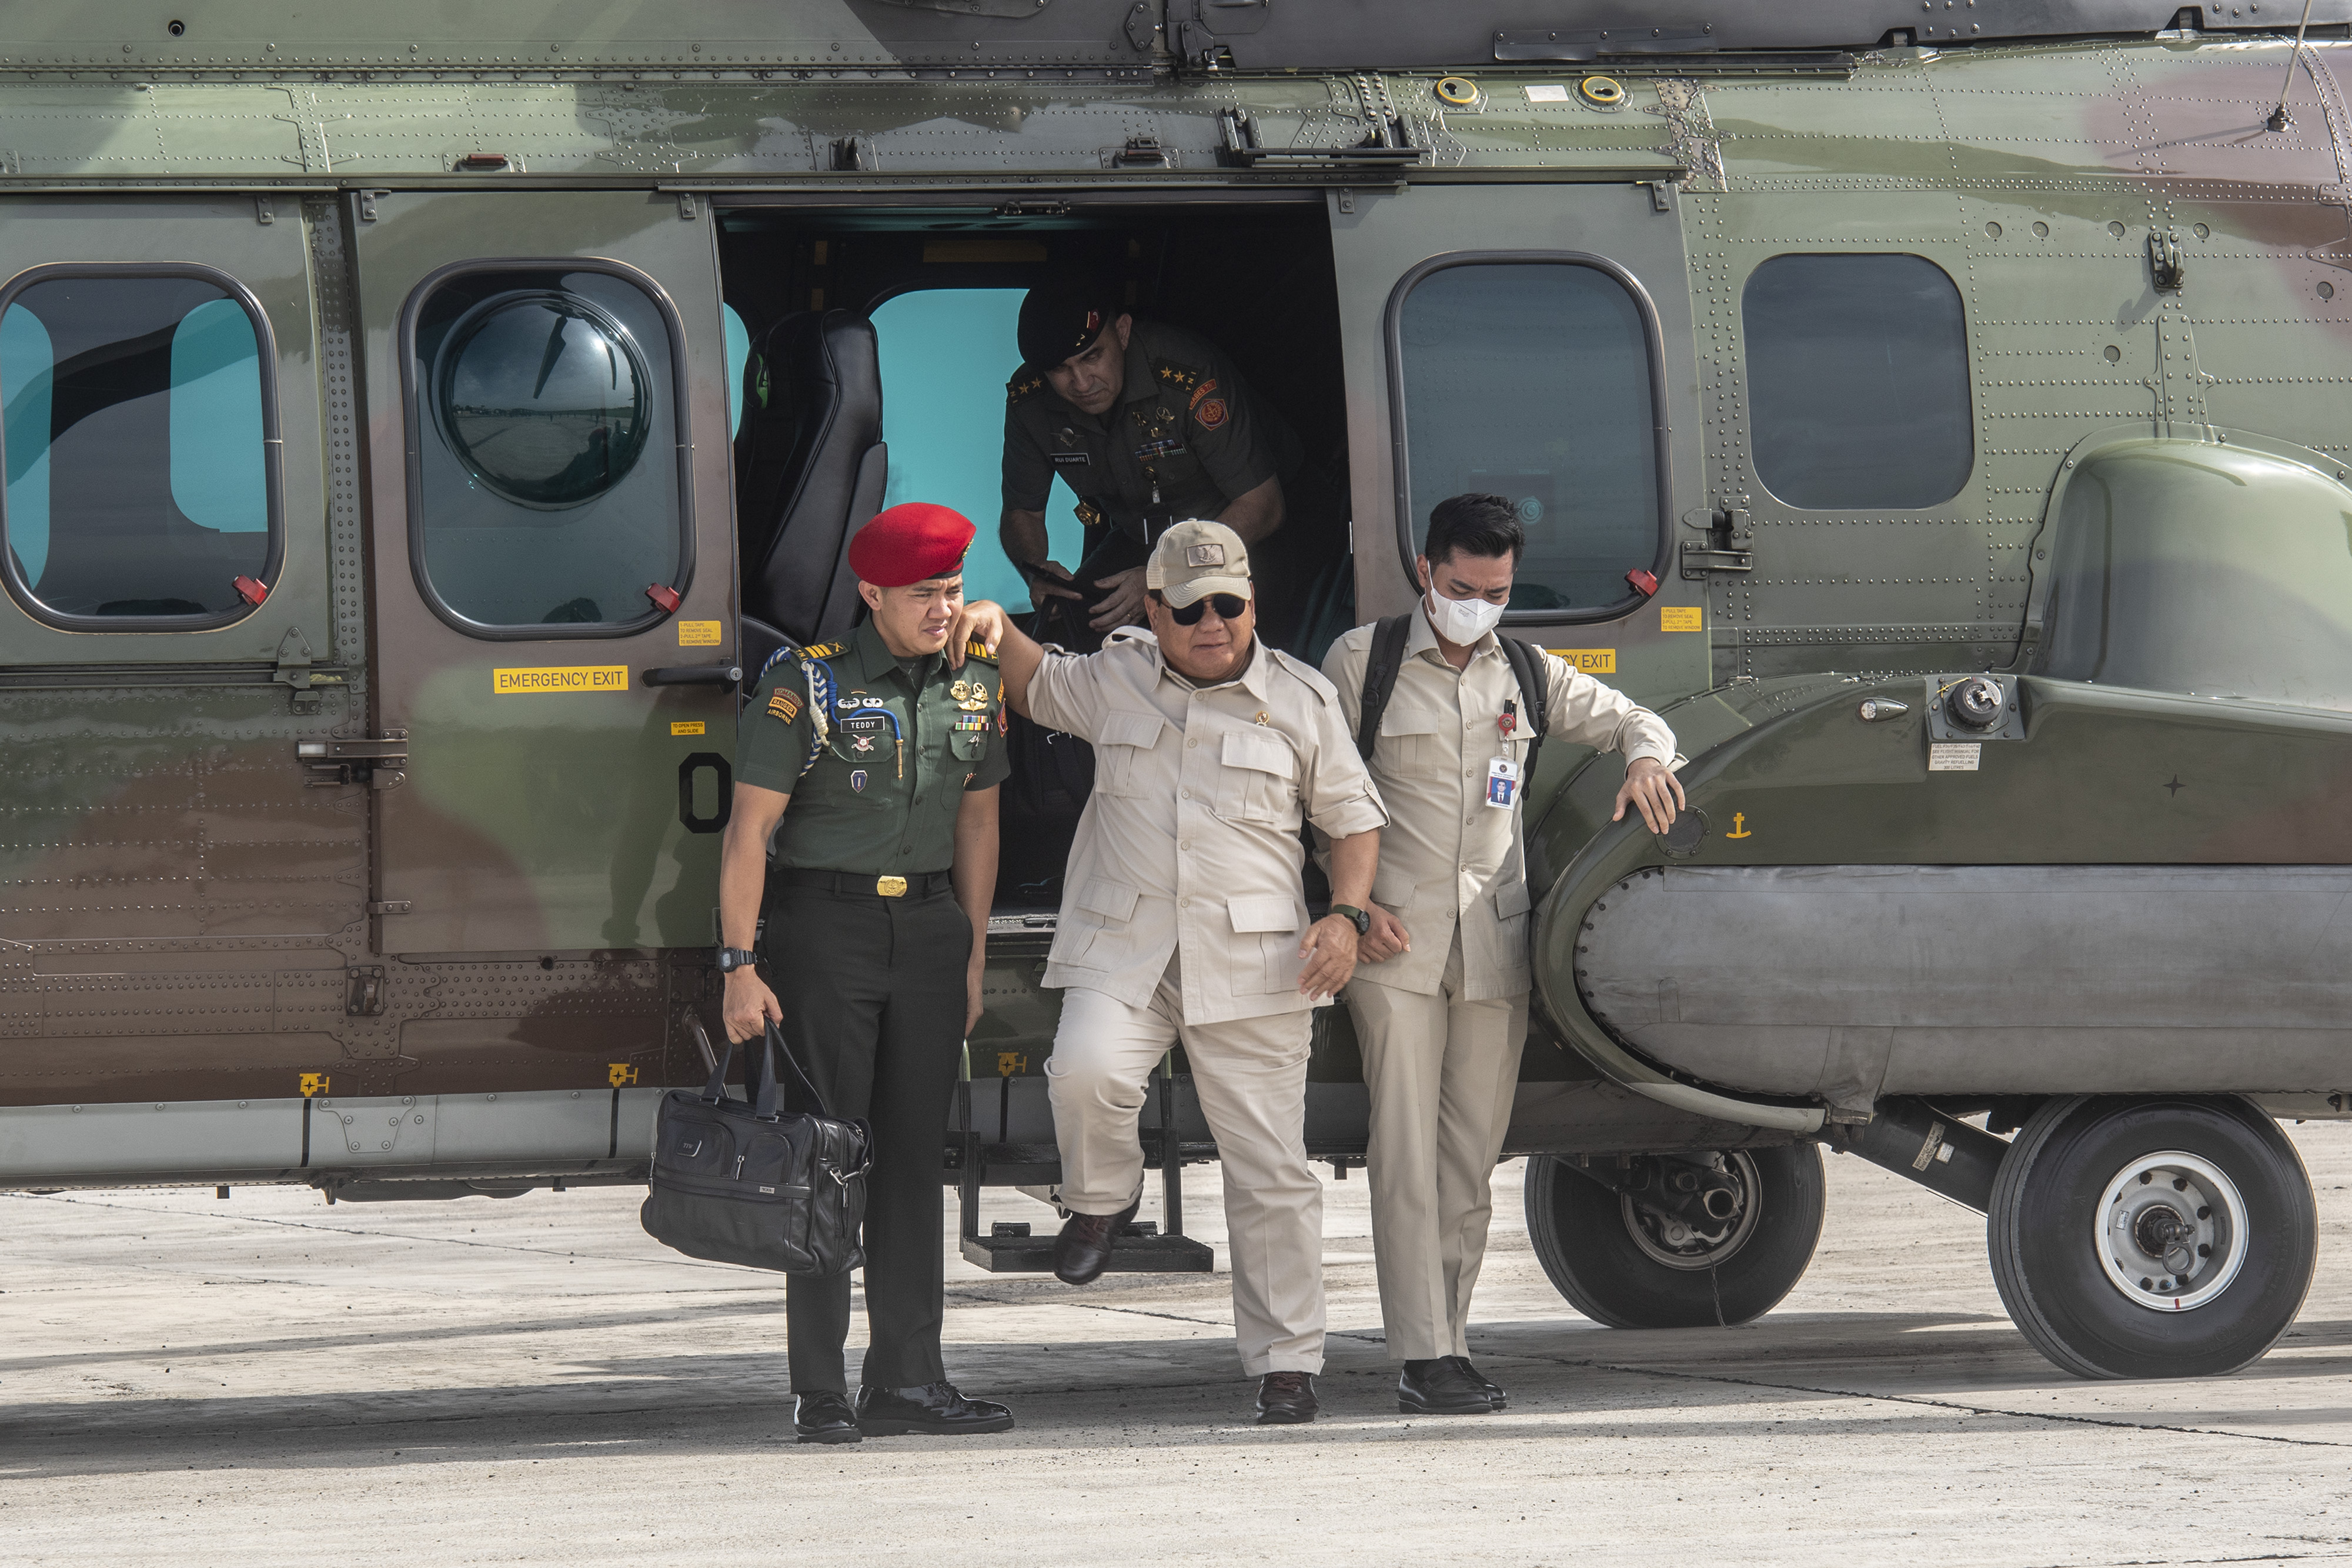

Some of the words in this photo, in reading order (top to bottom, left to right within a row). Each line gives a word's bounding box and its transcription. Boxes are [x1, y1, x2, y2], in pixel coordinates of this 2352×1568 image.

[1185, 371, 1197, 391] TNI
[796, 649, 808, 661] TNI
[1582, 654, 1611, 668] EXIT
[500, 672, 588, 687] EMERGENCY
[593, 671, 623, 685] EXIT
[776, 688, 801, 707] KOMANDO
[773, 699, 794, 713] RANGER
[767, 708, 791, 726] AIRBORNE
